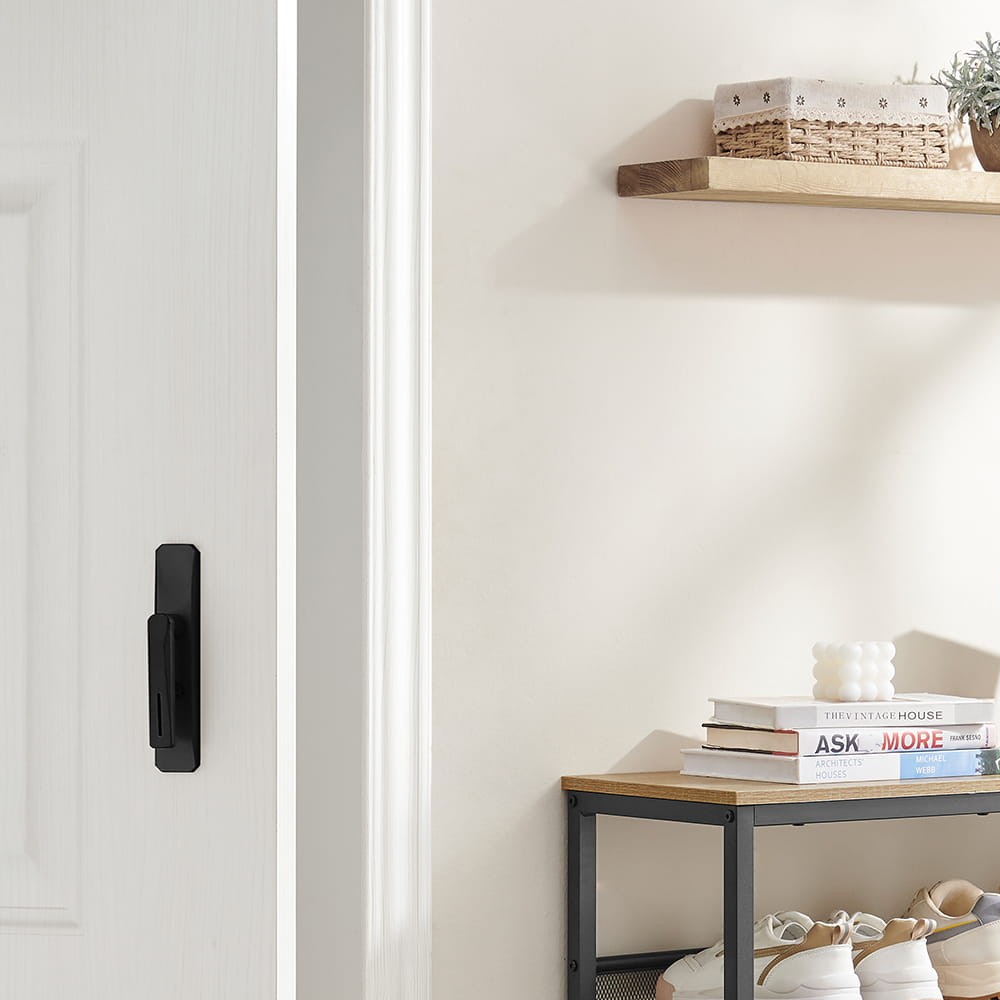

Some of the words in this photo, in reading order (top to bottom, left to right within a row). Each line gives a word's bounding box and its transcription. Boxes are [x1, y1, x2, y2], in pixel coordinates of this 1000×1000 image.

[815, 734, 859, 754] ASK
[881, 730, 943, 751] MORE
[915, 754, 946, 763] MICHAEL
[815, 770, 847, 779] HOUSES
[915, 766, 936, 774] WEBB
